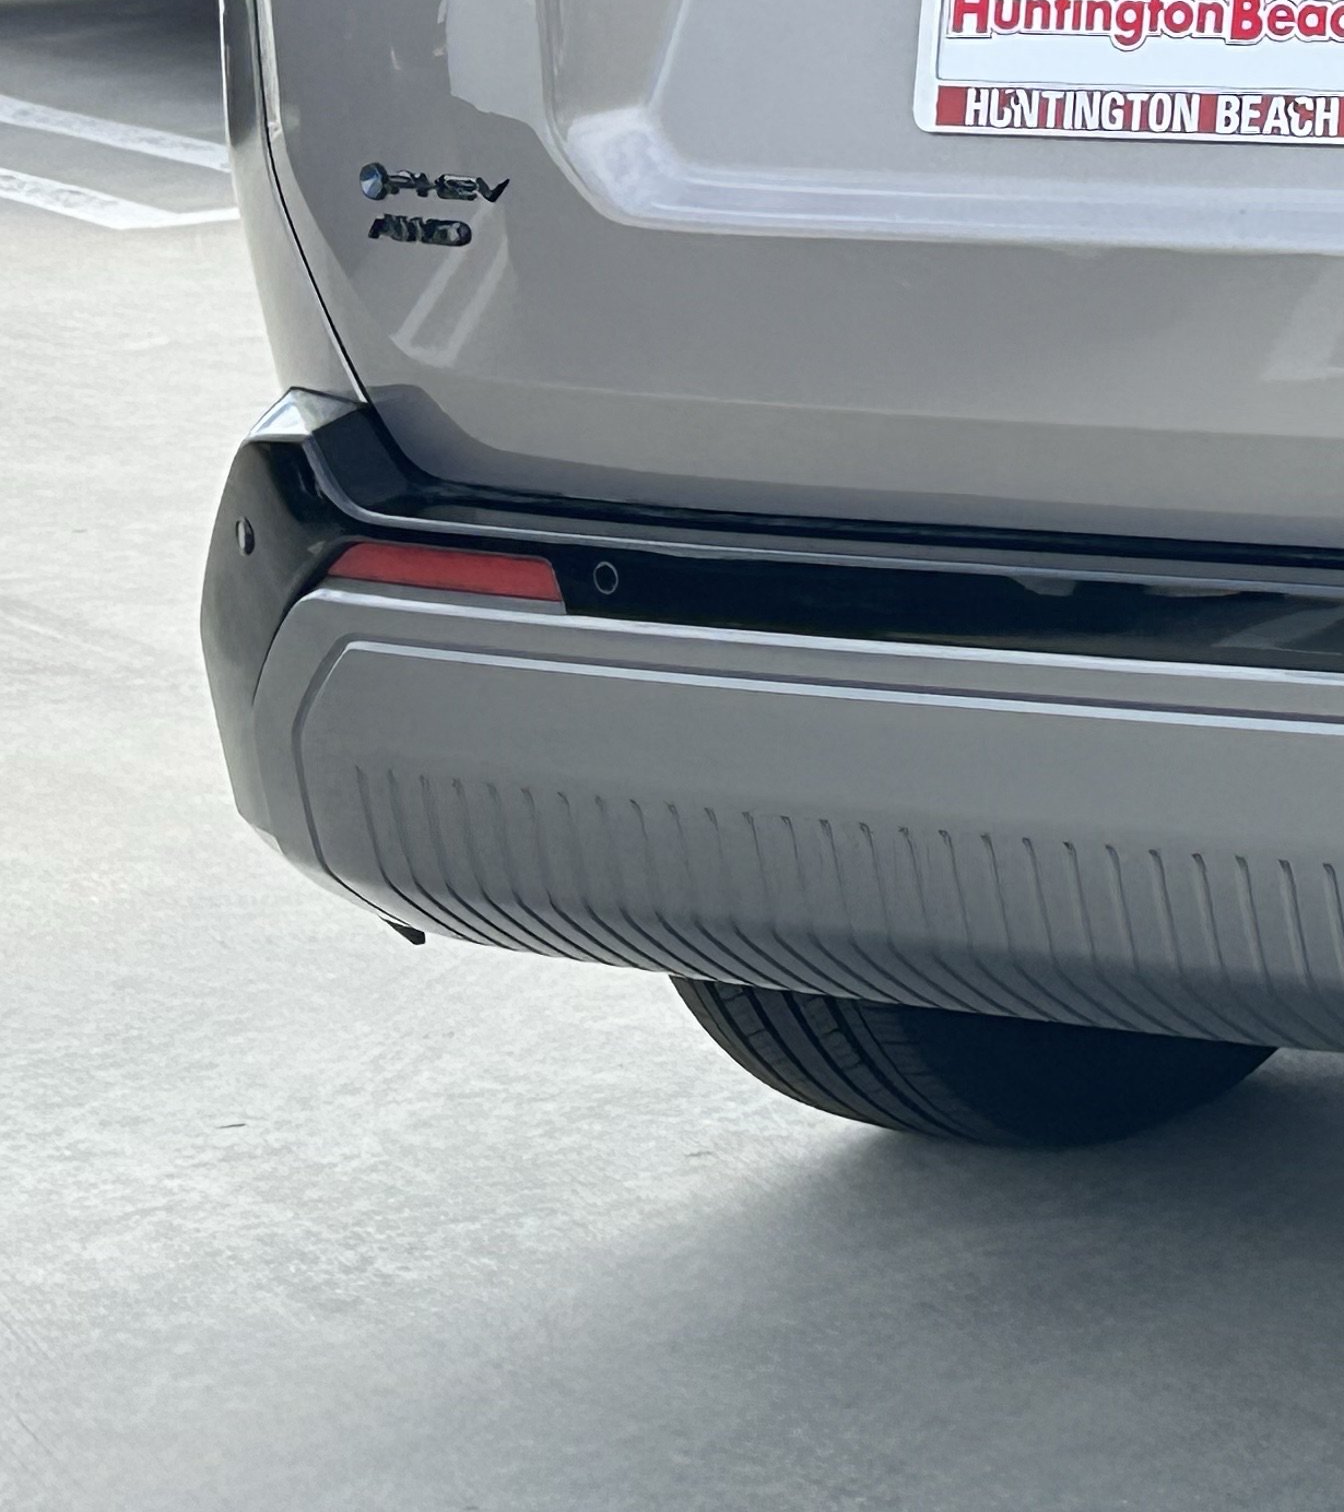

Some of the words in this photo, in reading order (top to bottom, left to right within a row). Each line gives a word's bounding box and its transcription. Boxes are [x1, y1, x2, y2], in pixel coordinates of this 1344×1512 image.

[965, 88, 1201, 133] HUNTINGTON
[1215, 94, 1340, 138] BEACH
[368, 213, 472, 247] AWD
